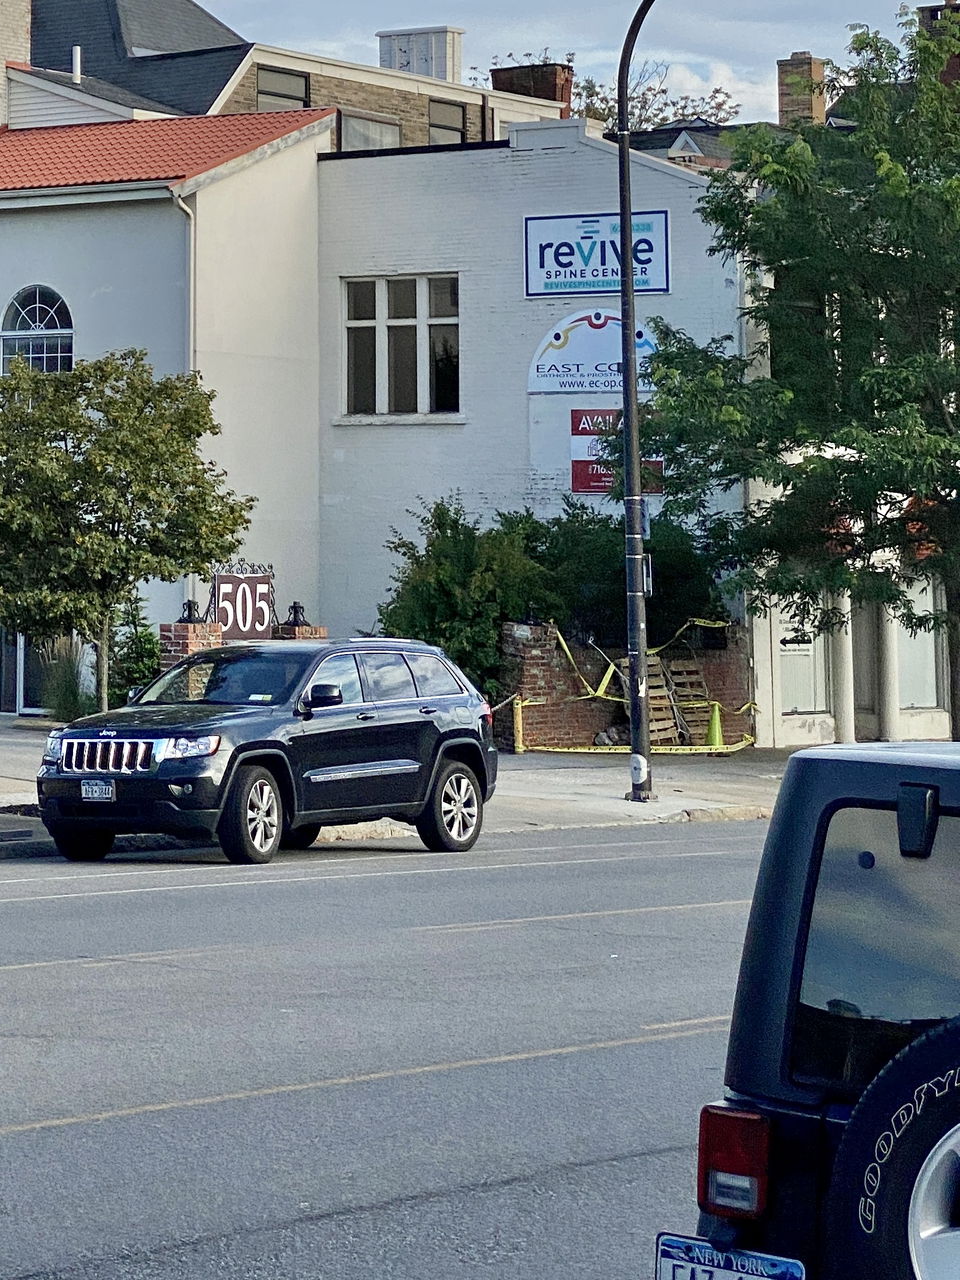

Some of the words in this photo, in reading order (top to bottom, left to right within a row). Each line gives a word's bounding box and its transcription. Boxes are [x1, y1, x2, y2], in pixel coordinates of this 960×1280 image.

[545, 269, 587, 280] SPINE
[591, 267, 649, 278] CENER
[536, 363, 585, 374] EAST
[218, 582, 270, 632] 505
[693, 1247, 726, 1268] NEW
[729, 1253, 769, 1277] YORK
